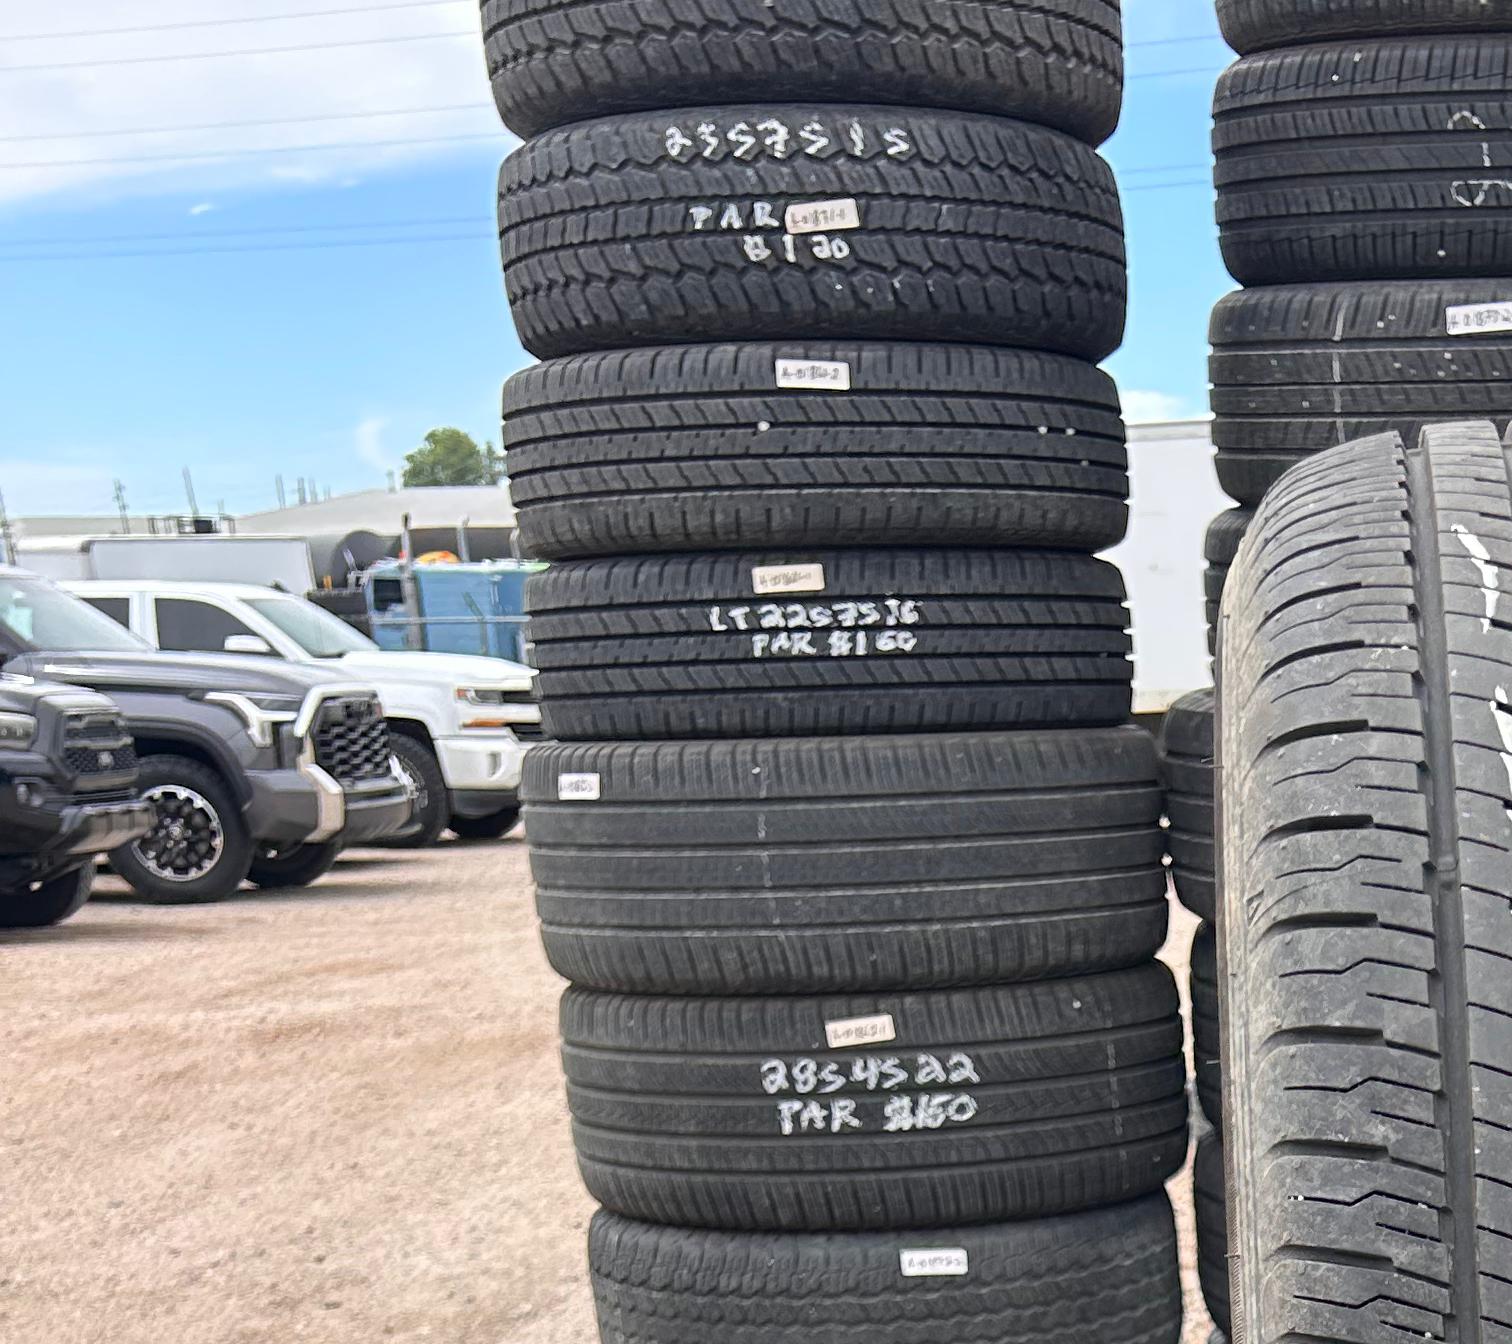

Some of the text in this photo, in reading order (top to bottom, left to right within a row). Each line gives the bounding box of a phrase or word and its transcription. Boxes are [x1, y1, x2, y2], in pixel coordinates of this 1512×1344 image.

[689, 202, 780, 229] PAR
[752, 631, 817, 658] PAR
[777, 1099, 864, 1136] PAR
